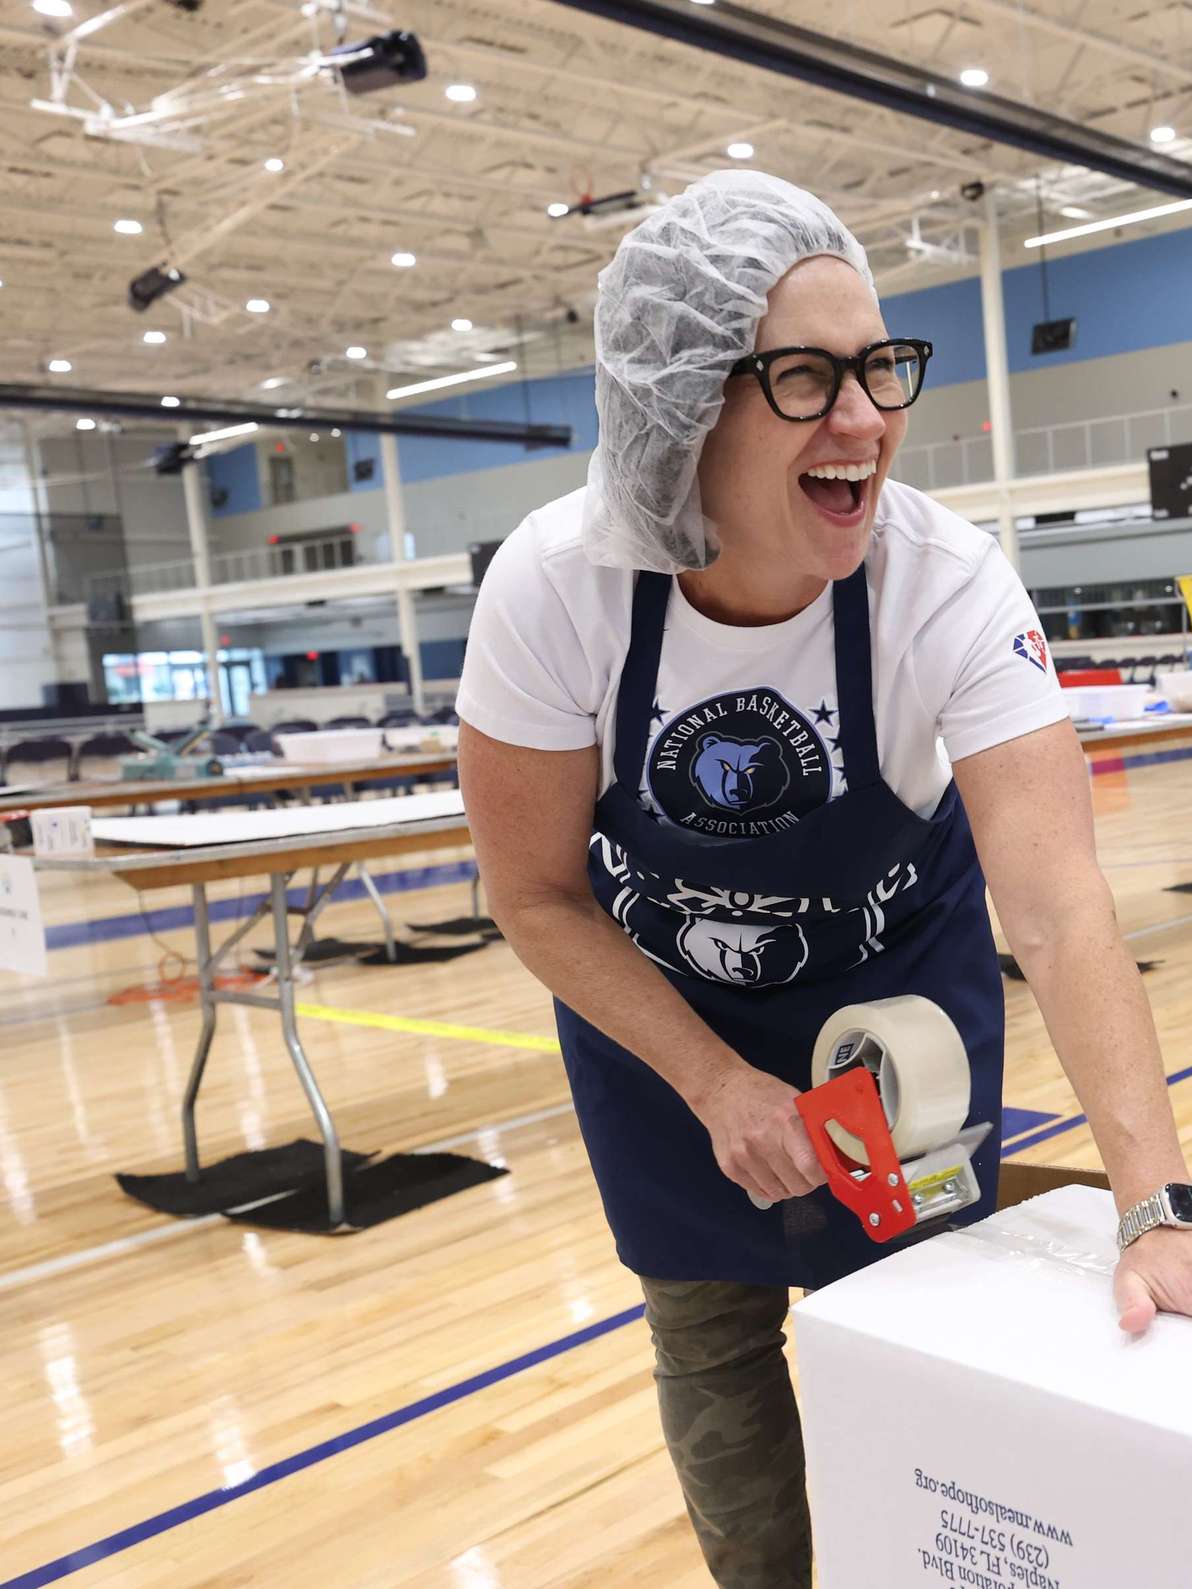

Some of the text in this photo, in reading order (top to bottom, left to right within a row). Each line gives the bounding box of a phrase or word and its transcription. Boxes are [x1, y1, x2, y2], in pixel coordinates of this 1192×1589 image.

[657, 695, 822, 776] NATIONAL BASKETBALL
[680, 811, 801, 835] ASSOCIATION
[914, 1467, 1074, 1547] www.mealsofhope.org
[935, 1532, 978, 1566] 34109
[940, 1509, 1050, 1570] (239) 537-7775
[917, 1547, 955, 1582] Blvd.
[980, 1550, 1002, 1577] FL
